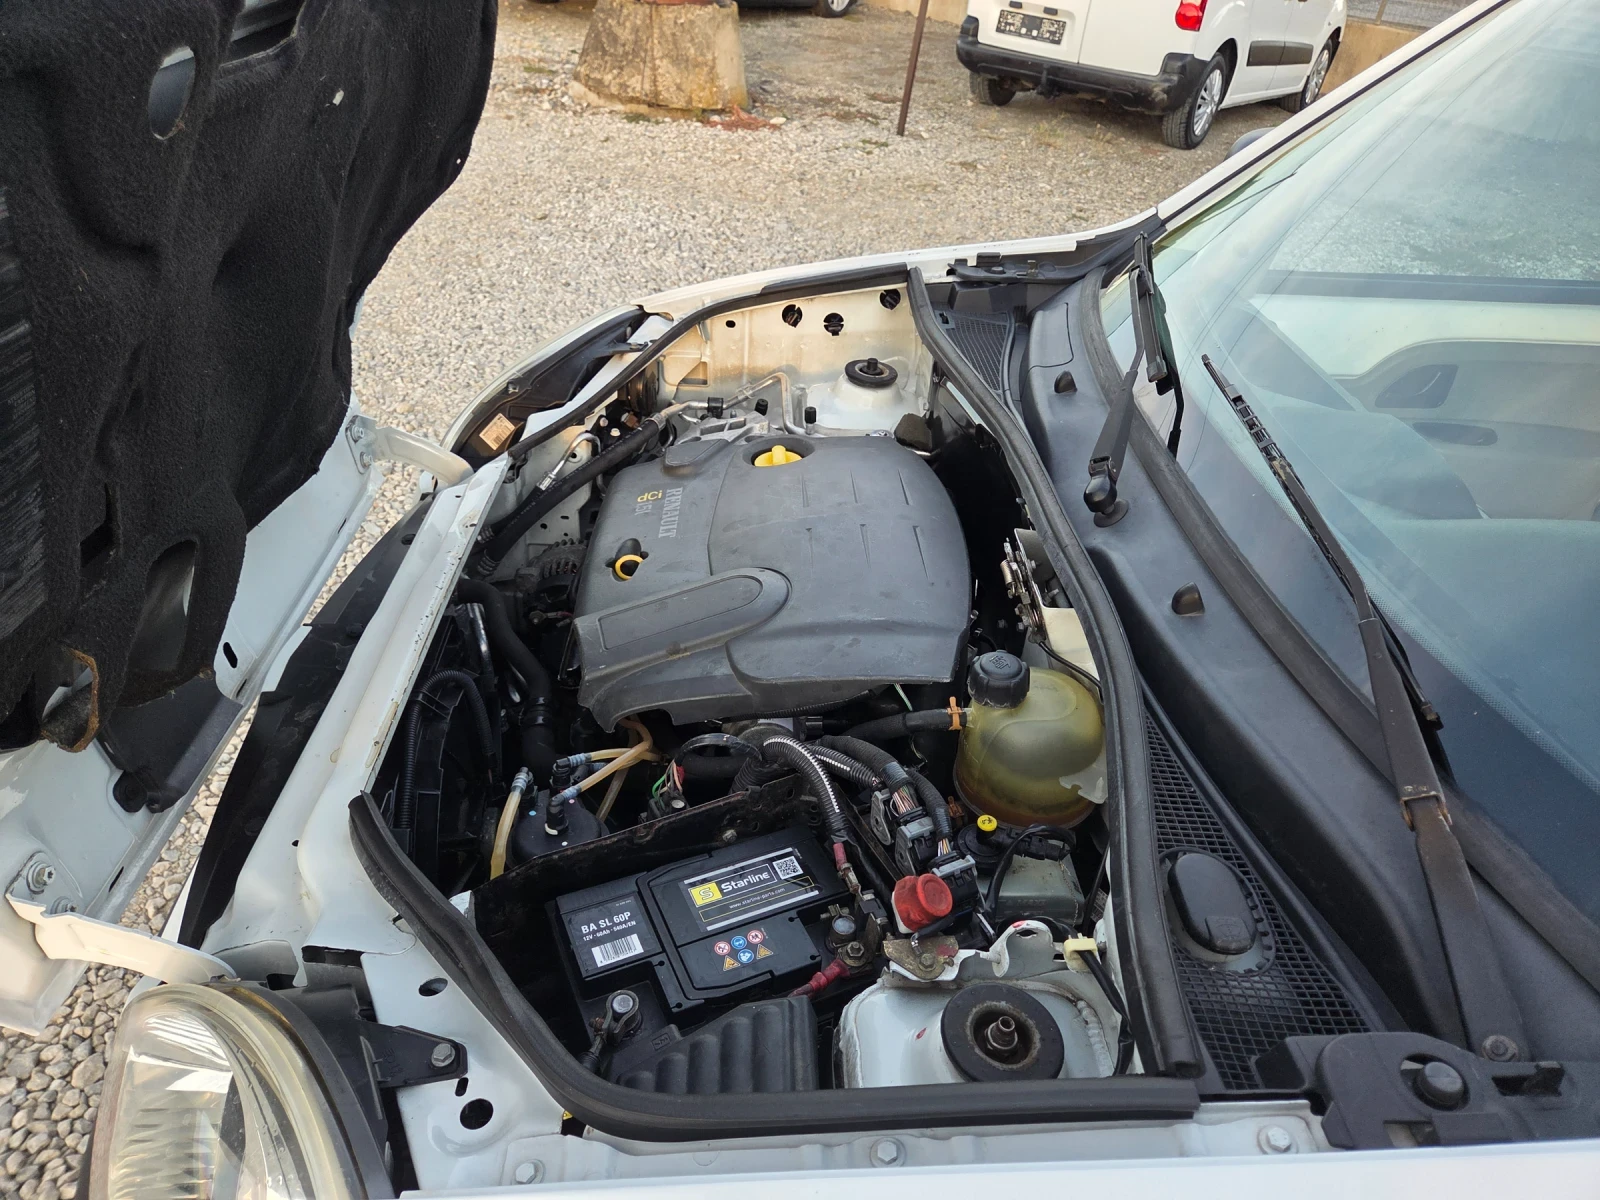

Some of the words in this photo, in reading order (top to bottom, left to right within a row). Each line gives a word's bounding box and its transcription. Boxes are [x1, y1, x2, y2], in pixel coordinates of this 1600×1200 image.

[637, 490, 663, 502] dCi
[658, 487, 683, 538] RENAULT
[721, 871, 771, 893] Starline
[729, 887, 785, 909] www.starline-parts.com
[581, 924, 597, 934] BA
[598, 919, 612, 928] SL
[613, 911, 631, 923] 60P
[597, 929, 610, 937] 60Ah
[613, 920, 636, 931] 540A/EN
